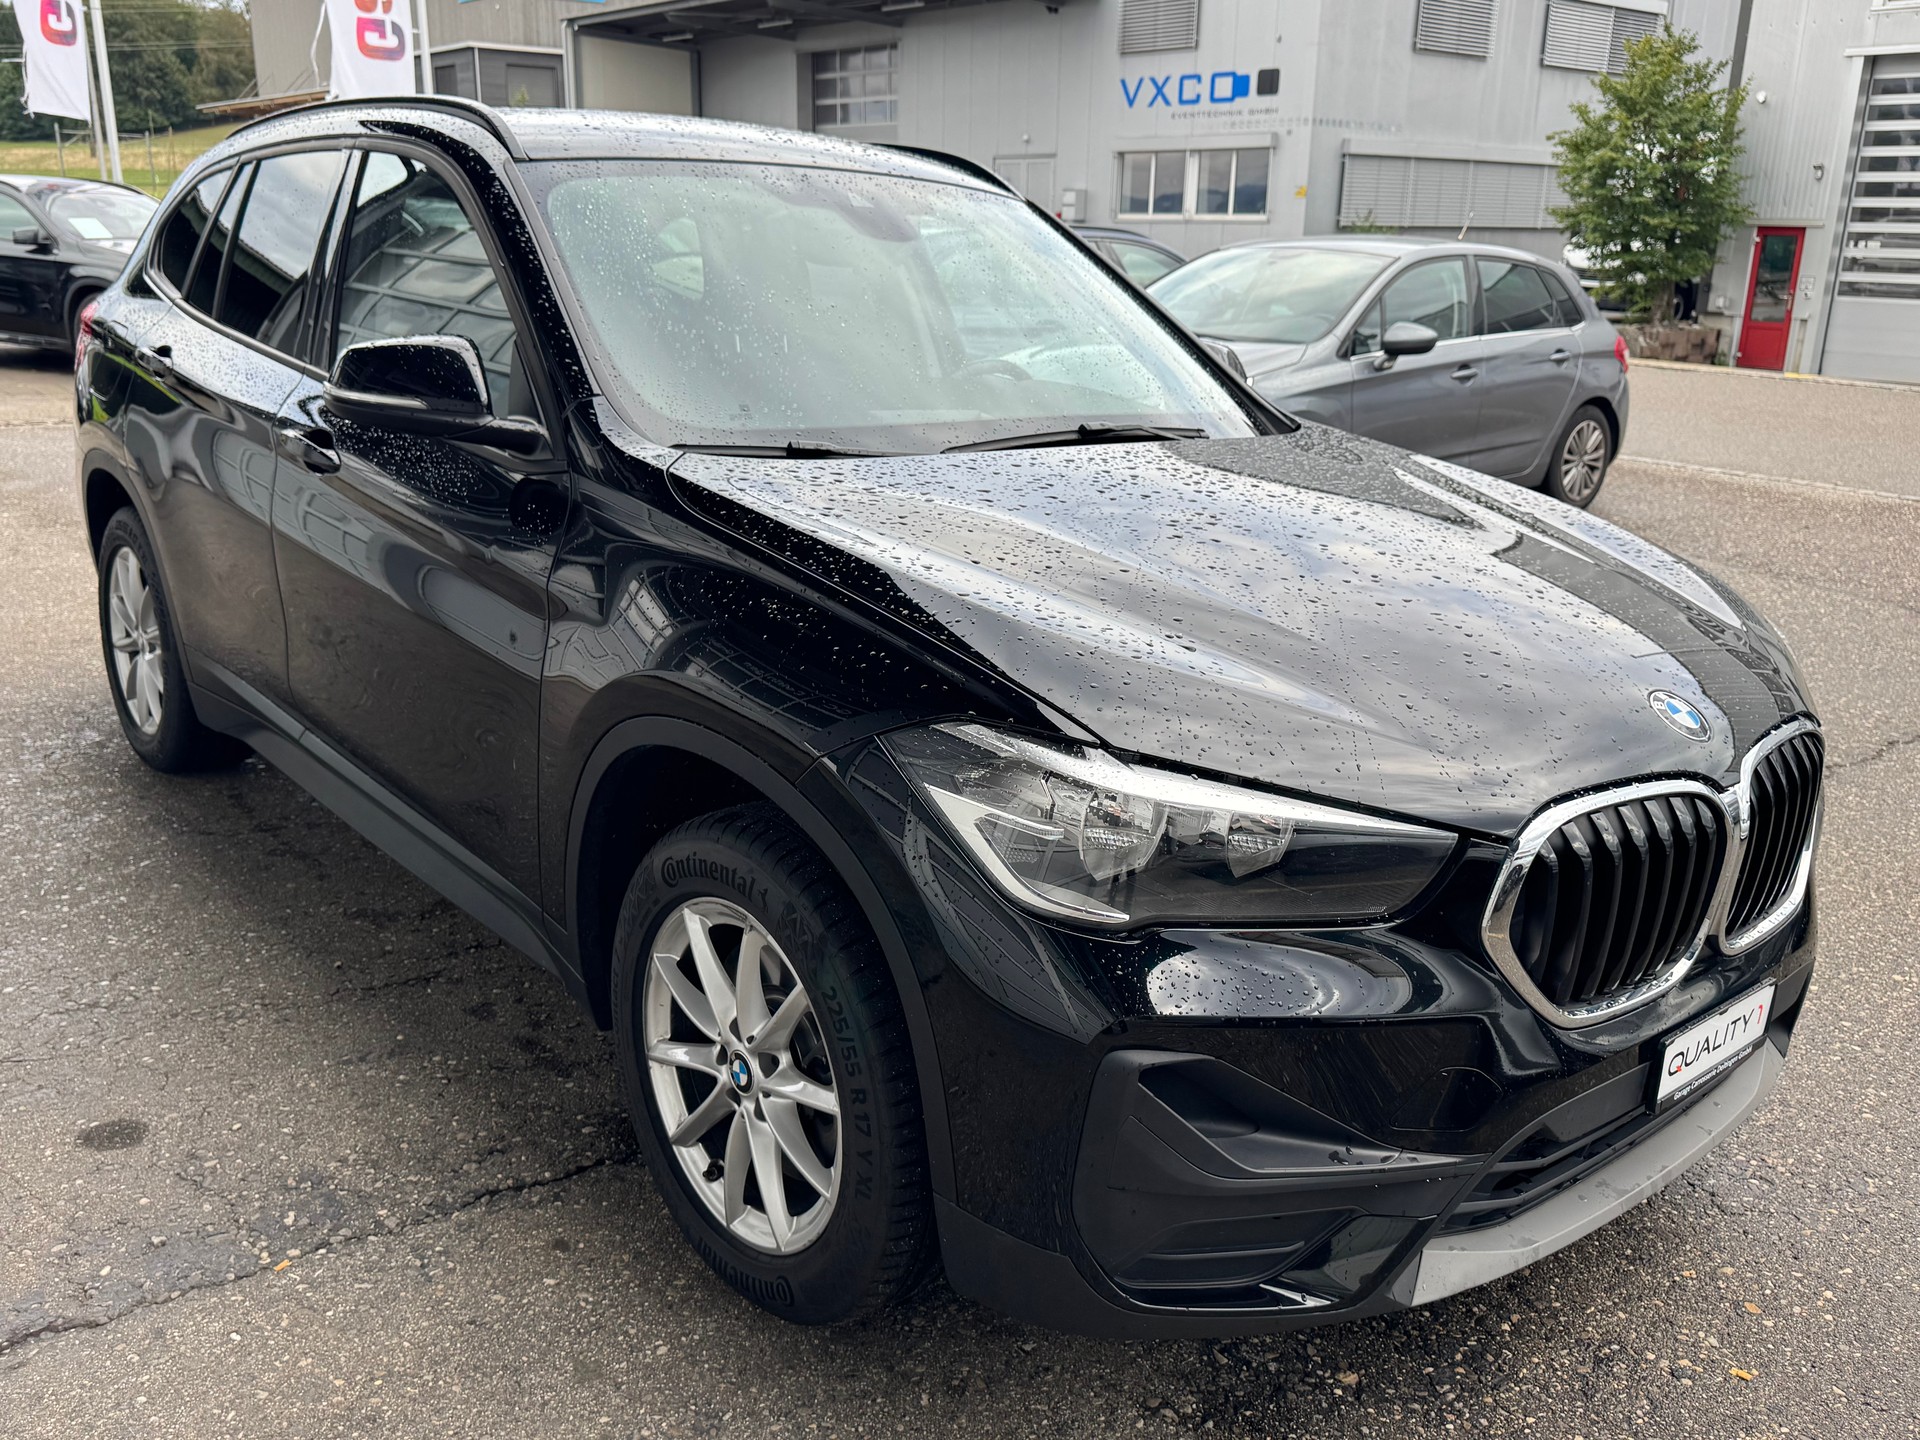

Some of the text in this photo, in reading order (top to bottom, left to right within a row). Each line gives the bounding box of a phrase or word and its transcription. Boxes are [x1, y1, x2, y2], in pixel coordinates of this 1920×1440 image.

[1120, 71, 1240, 109] VXCO
[1170, 108, 1243, 120] EVENTTECHNIK
[660, 851, 756, 903] Continental
[821, 986, 862, 1078] 225/55
[1668, 1004, 1764, 1077] QUALITY 1
